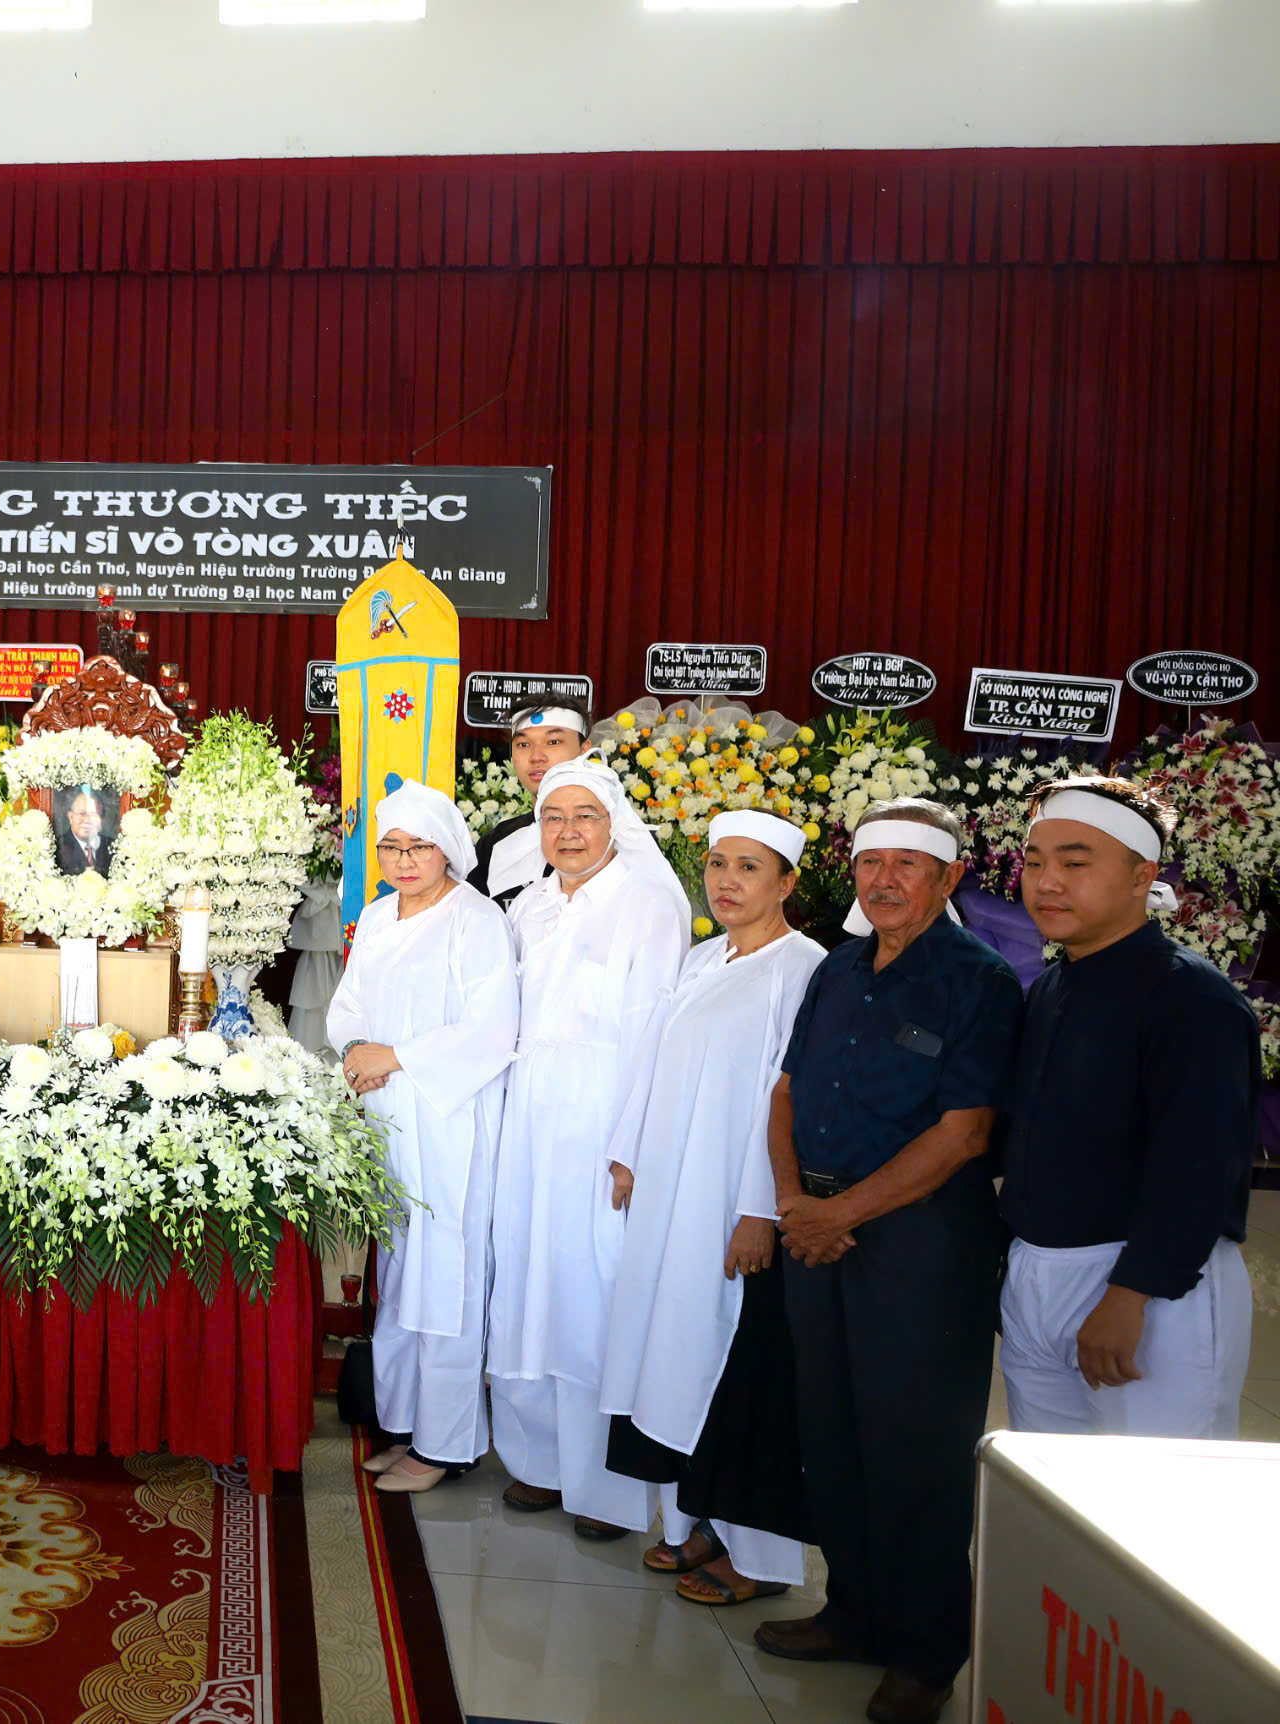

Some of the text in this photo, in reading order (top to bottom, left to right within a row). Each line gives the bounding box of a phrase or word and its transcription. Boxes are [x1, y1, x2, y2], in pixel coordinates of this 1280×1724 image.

[54, 489, 307, 520] THƯƠNG
[325, 479, 467, 522] TIẾC
[85, 526, 119, 555] SĨ
[128, 527, 183, 556] VÕ
[192, 528, 298, 558] TÒNG
[307, 530, 415, 559] XUÂN
[27, 560, 55, 577] học
[60, 560, 91, 574] Cần
[97, 561, 130, 576] Thơ,
[136, 563, 194, 578] Nguyên
[200, 563, 237, 579] Hiệu
[243, 564, 295, 580] trưởng
[301, 565, 357, 581] Trường
[431, 567, 452, 580] An
[458, 568, 506, 584] Giang
[3, 581, 39, 597] Hiệu
[44, 581, 95, 597] trưởng
[147, 584, 168, 599] dự
[173, 584, 227, 600] Trường
[233, 586, 260, 601] Đại
[266, 586, 294, 602] học
[301, 587, 336, 600] Nam
[659, 650, 751, 666] TS-LS Nguyễn Tiến Dũng
[853, 657, 903, 672] HĐT và BGH
[1157, 658, 1231, 673] HỘI ĐỒNG DÒNG HỌ
[472, 676, 545, 694] TỈNH ỦY HĐND UBND
[820, 671, 932, 689] Trường Đại học Nam Cần Thơ
[1145, 671, 1244, 688] VŨ-VÕ TP CẦN THƠ
[483, 693, 511, 708] TỈNH
[980, 679, 1109, 706] SỞ KHOA HỌC VÀ CÔNG NGHỆ
[1163, 687, 1223, 699] KÍNH VIẾNG
[988, 699, 1096, 719] TP. CẦN THƠ
[988, 713, 1091, 732] Kính Viếng
[1042, 1584, 1192, 1724] THÙN
